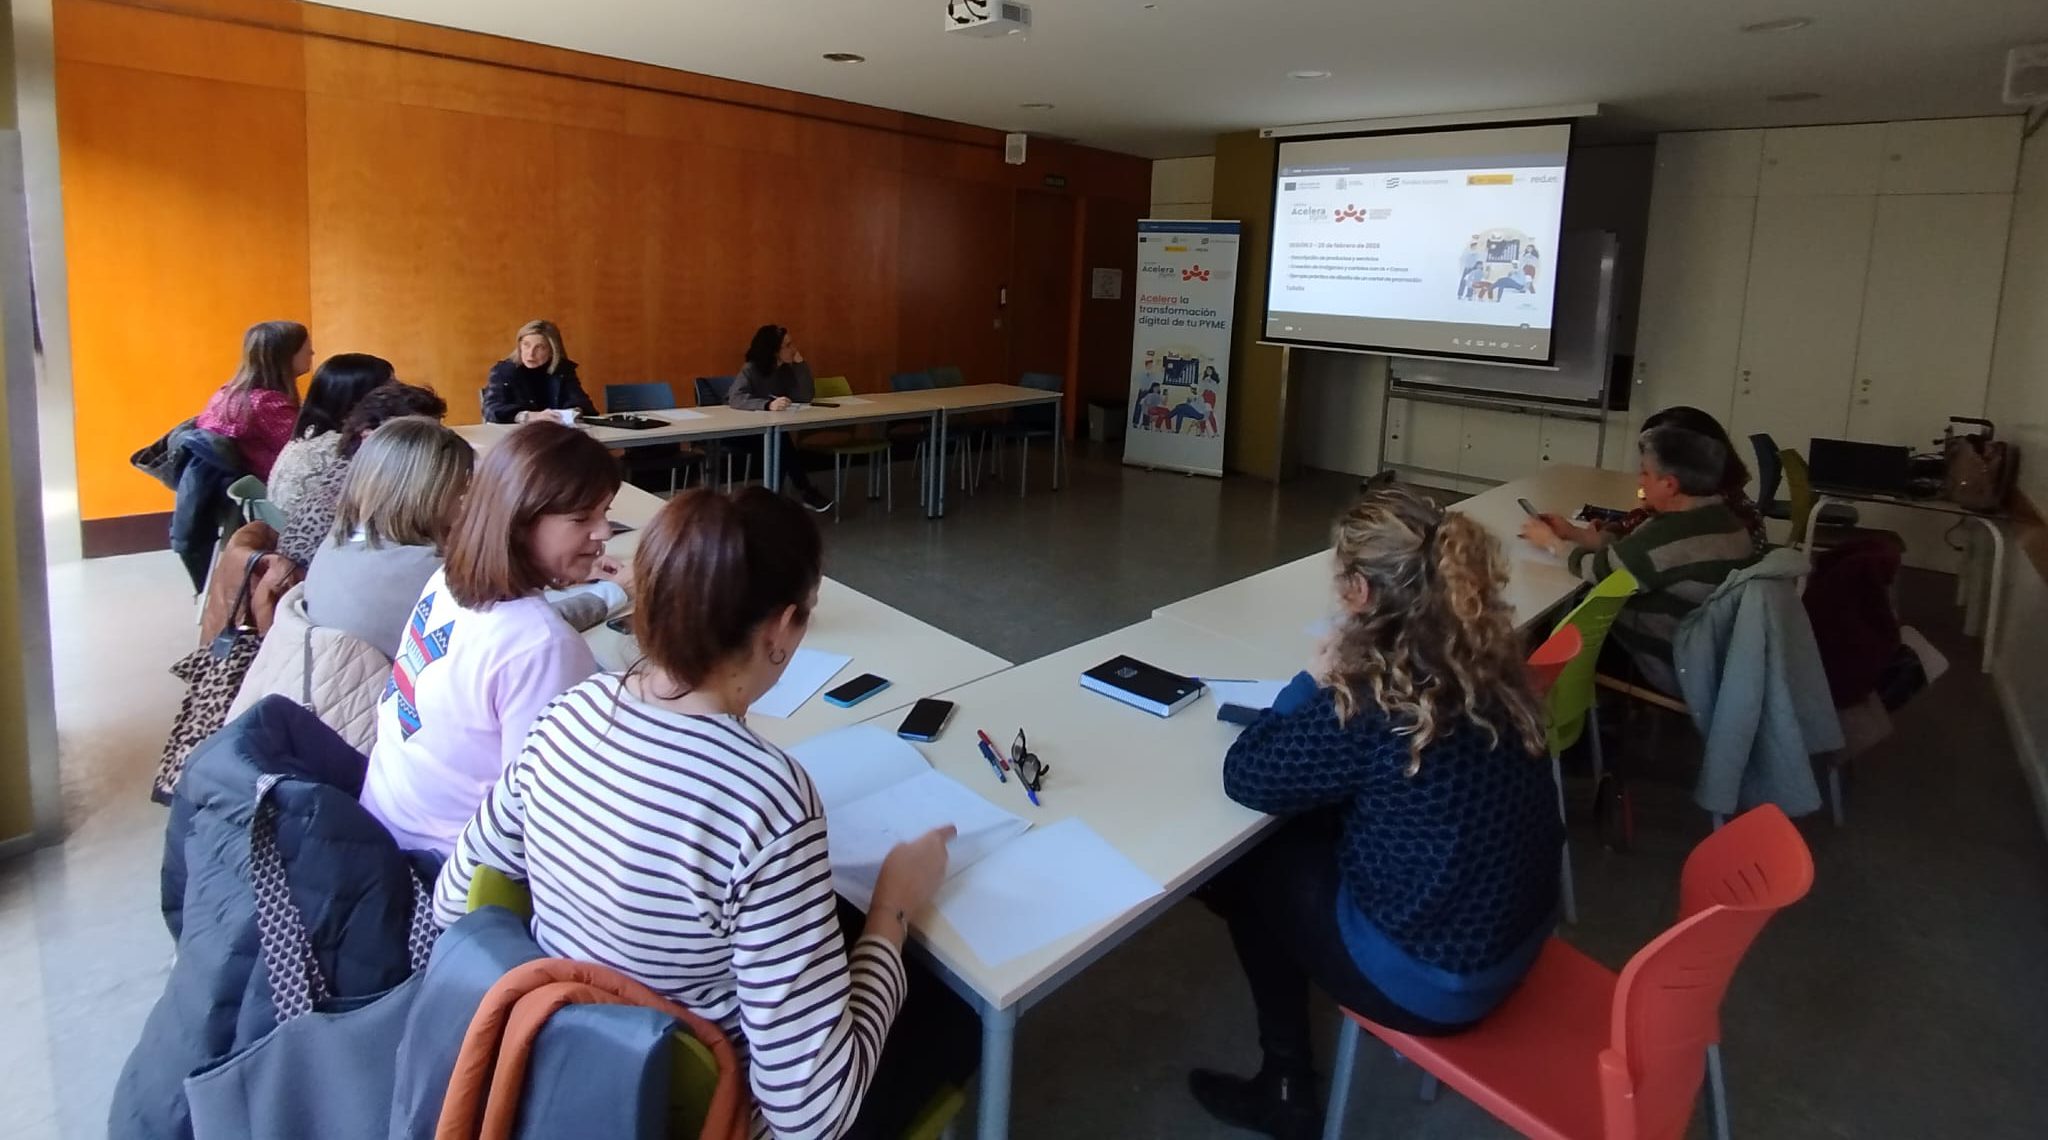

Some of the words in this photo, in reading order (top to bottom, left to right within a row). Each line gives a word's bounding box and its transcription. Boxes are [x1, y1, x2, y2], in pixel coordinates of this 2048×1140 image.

[1291, 205, 1327, 216] Acelera
[1142, 264, 1175, 274] Acelera
[1140, 294, 1178, 305] Acelera
[1180, 295, 1190, 304] la
[1139, 305, 1217, 317] transformación
[1138, 315, 1170, 327] digital
[1171, 318, 1185, 327] de
[1187, 320, 1197, 328] tu
[1199, 320, 1226, 330] PYME
